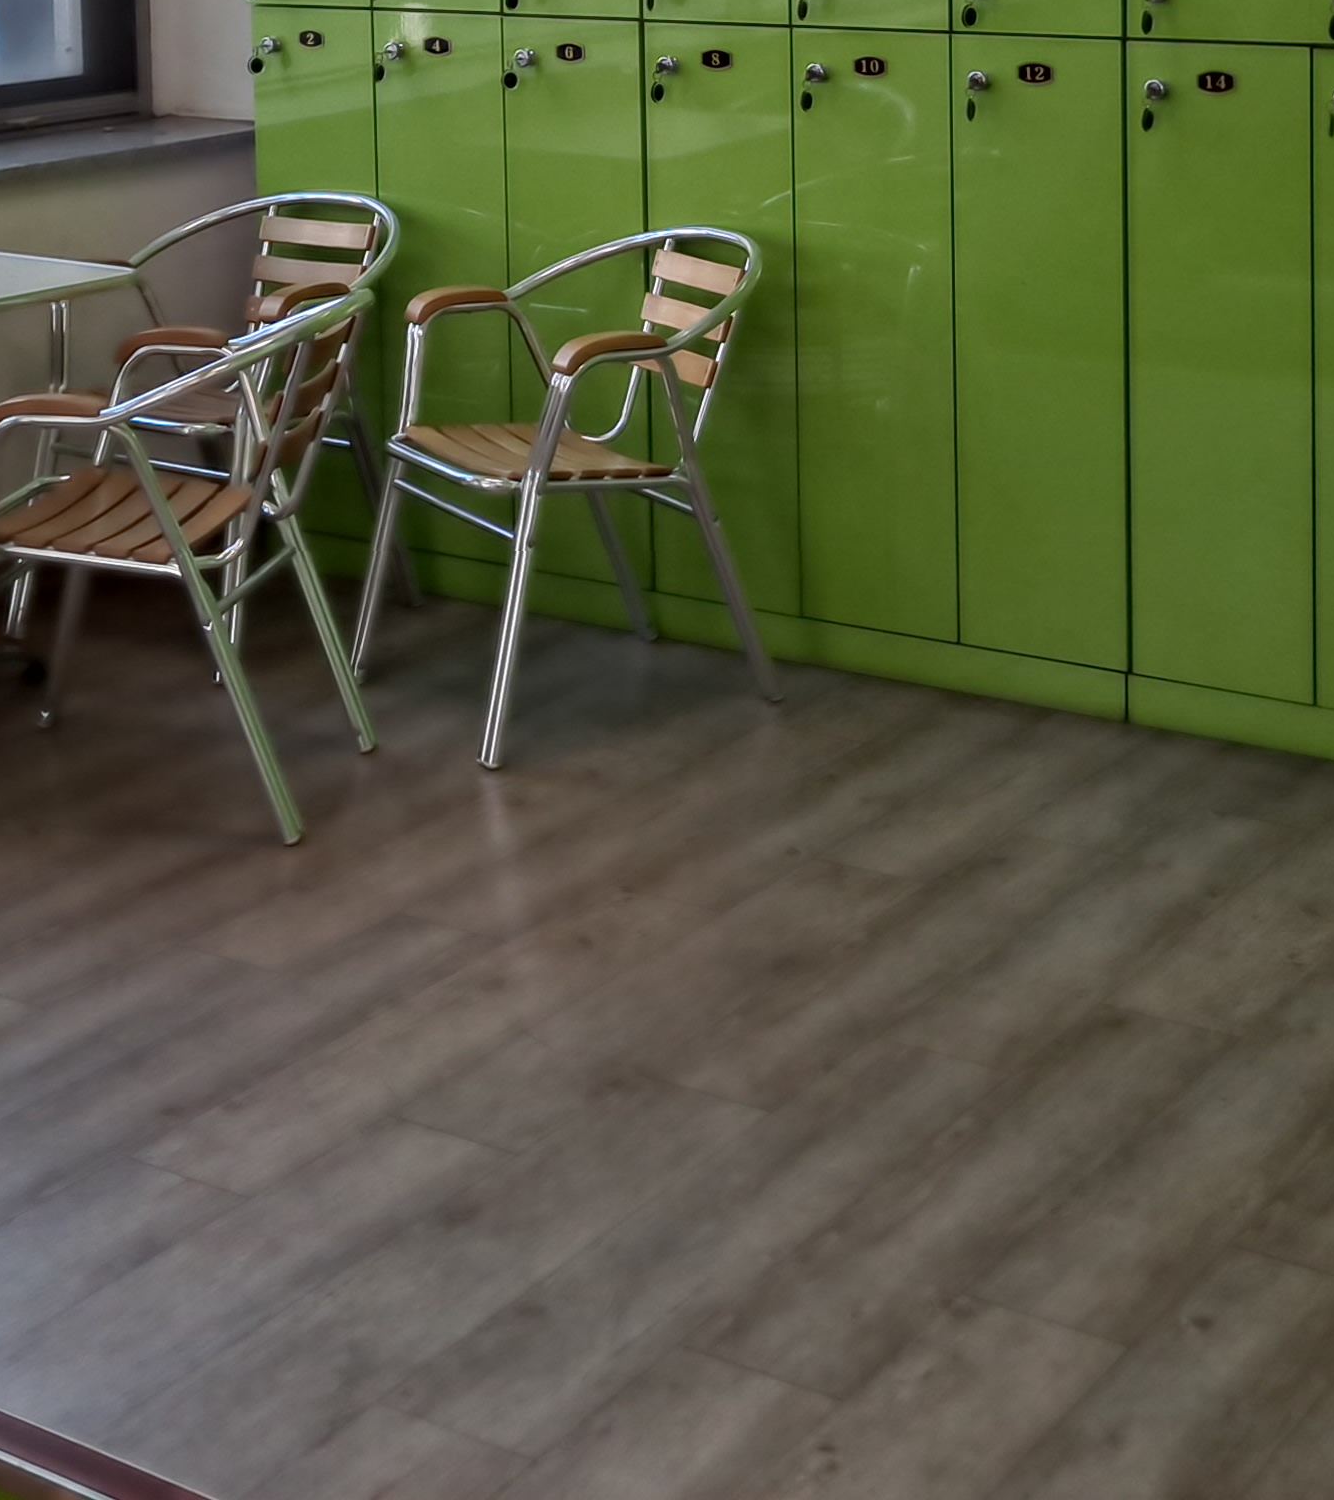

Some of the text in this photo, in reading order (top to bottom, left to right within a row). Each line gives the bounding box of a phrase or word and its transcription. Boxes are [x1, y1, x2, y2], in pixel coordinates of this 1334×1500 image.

[306, 33, 314, 45] 2
[432, 41, 440, 52] 4
[565, 47, 573, 58] 6
[712, 53, 720, 65] 8
[862, 61, 879, 73] 10
[1025, 68, 1044, 80] 12
[1206, 75, 1225, 88] 14
